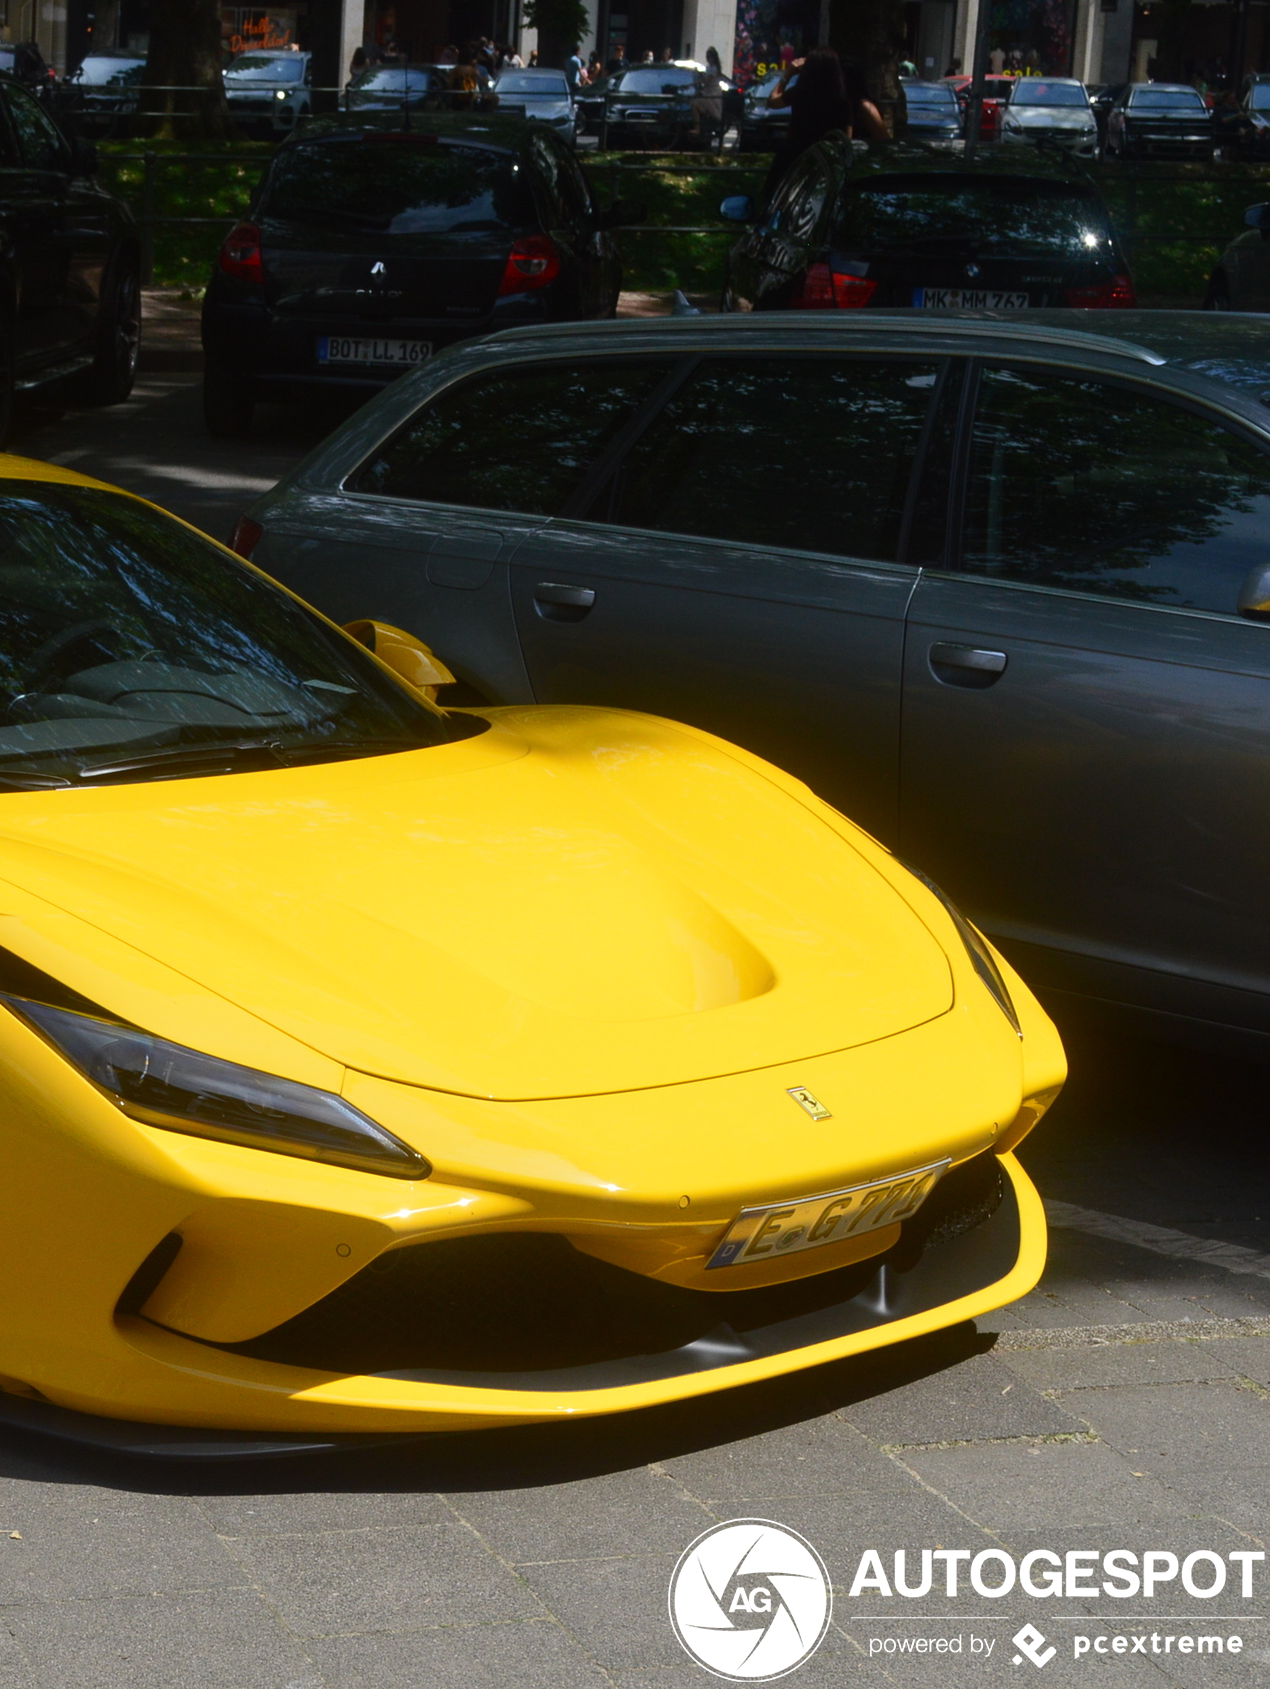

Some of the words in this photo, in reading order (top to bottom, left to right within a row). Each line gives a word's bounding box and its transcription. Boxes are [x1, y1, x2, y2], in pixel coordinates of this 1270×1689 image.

[924, 290, 949, 307] MK
[962, 291, 987, 307] MM
[993, 292, 1027, 307] 767
[329, 339, 362, 358] BOT
[373, 341, 393, 360] LL
[398, 343, 429, 361] 169
[743, 1209, 796, 1257] E
[806, 1197, 852, 1242] G
[846, 1172, 933, 1233] 771
